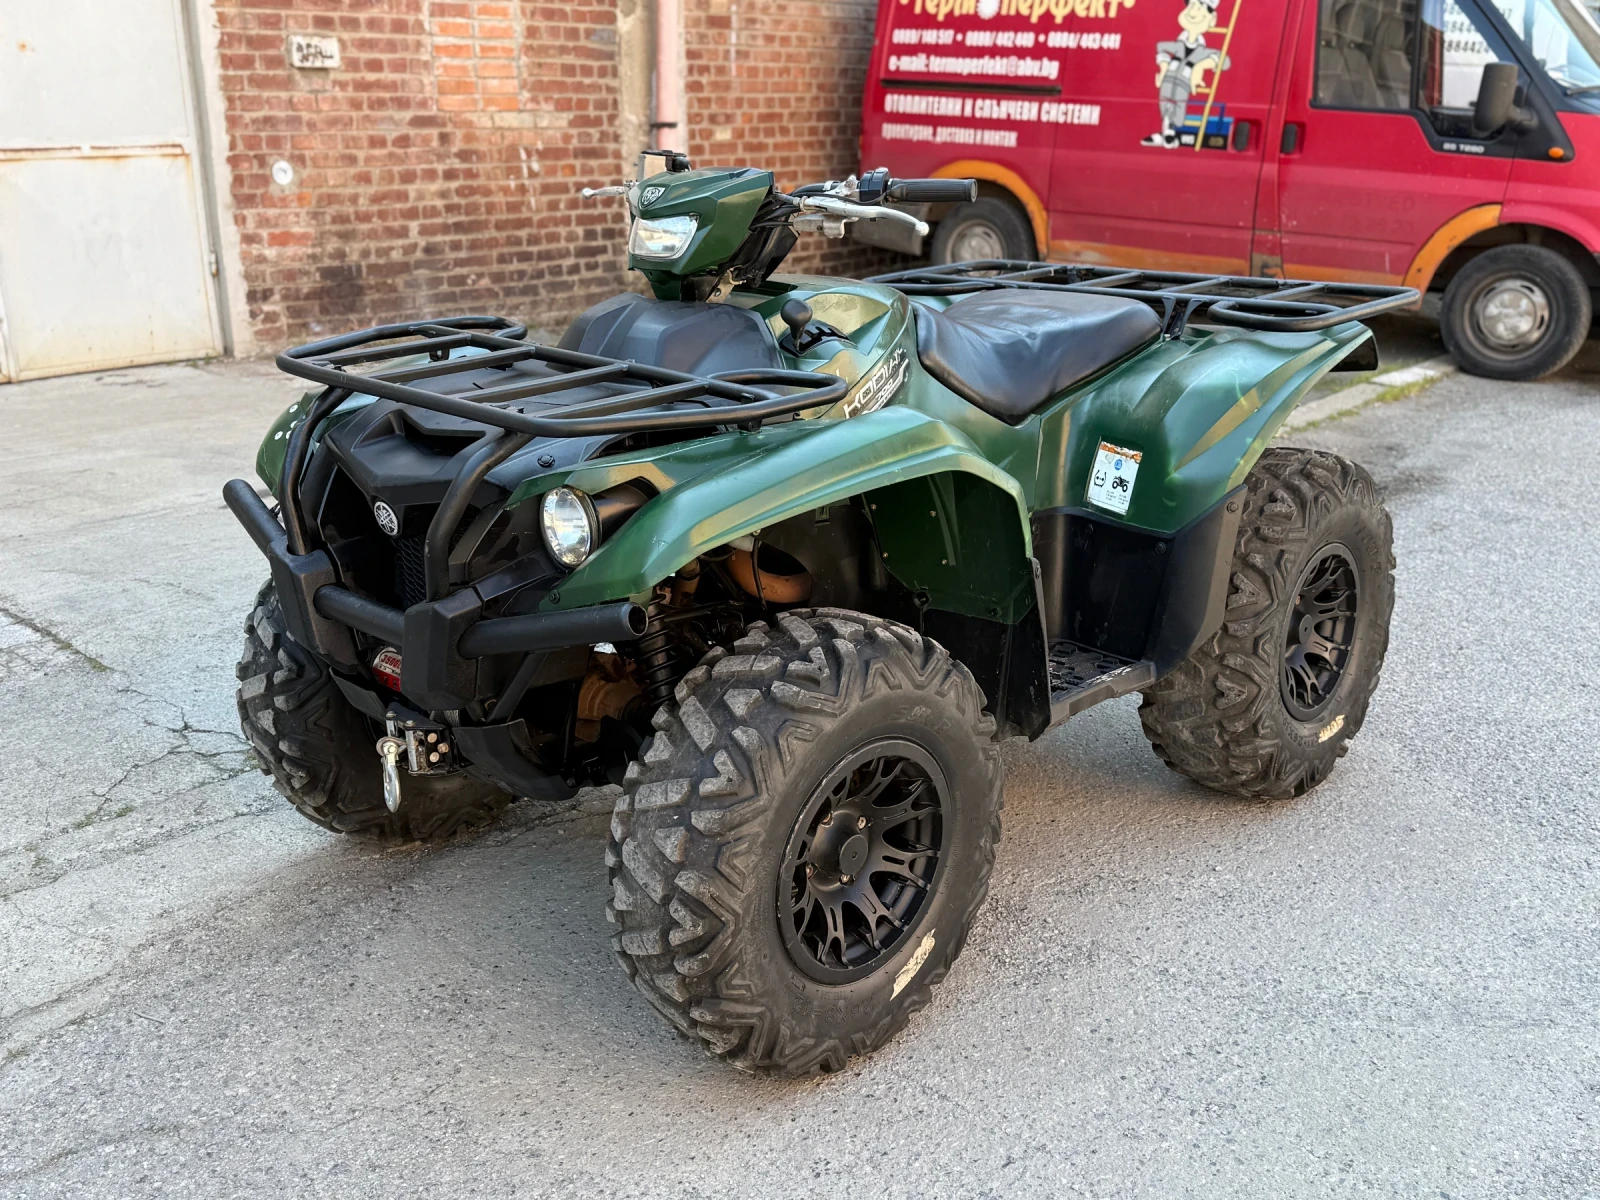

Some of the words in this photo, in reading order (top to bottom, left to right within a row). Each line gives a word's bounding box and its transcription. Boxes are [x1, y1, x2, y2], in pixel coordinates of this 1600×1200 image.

[888, 52, 928, 72] e-mail:
[884, 93, 963, 117] ОТОПЛИТЕЛНИ
[962, 97, 974, 118] И
[973, 98, 1040, 122] СЛЪНЧЕВИ
[1040, 101, 1101, 126] СИСТЕМИ
